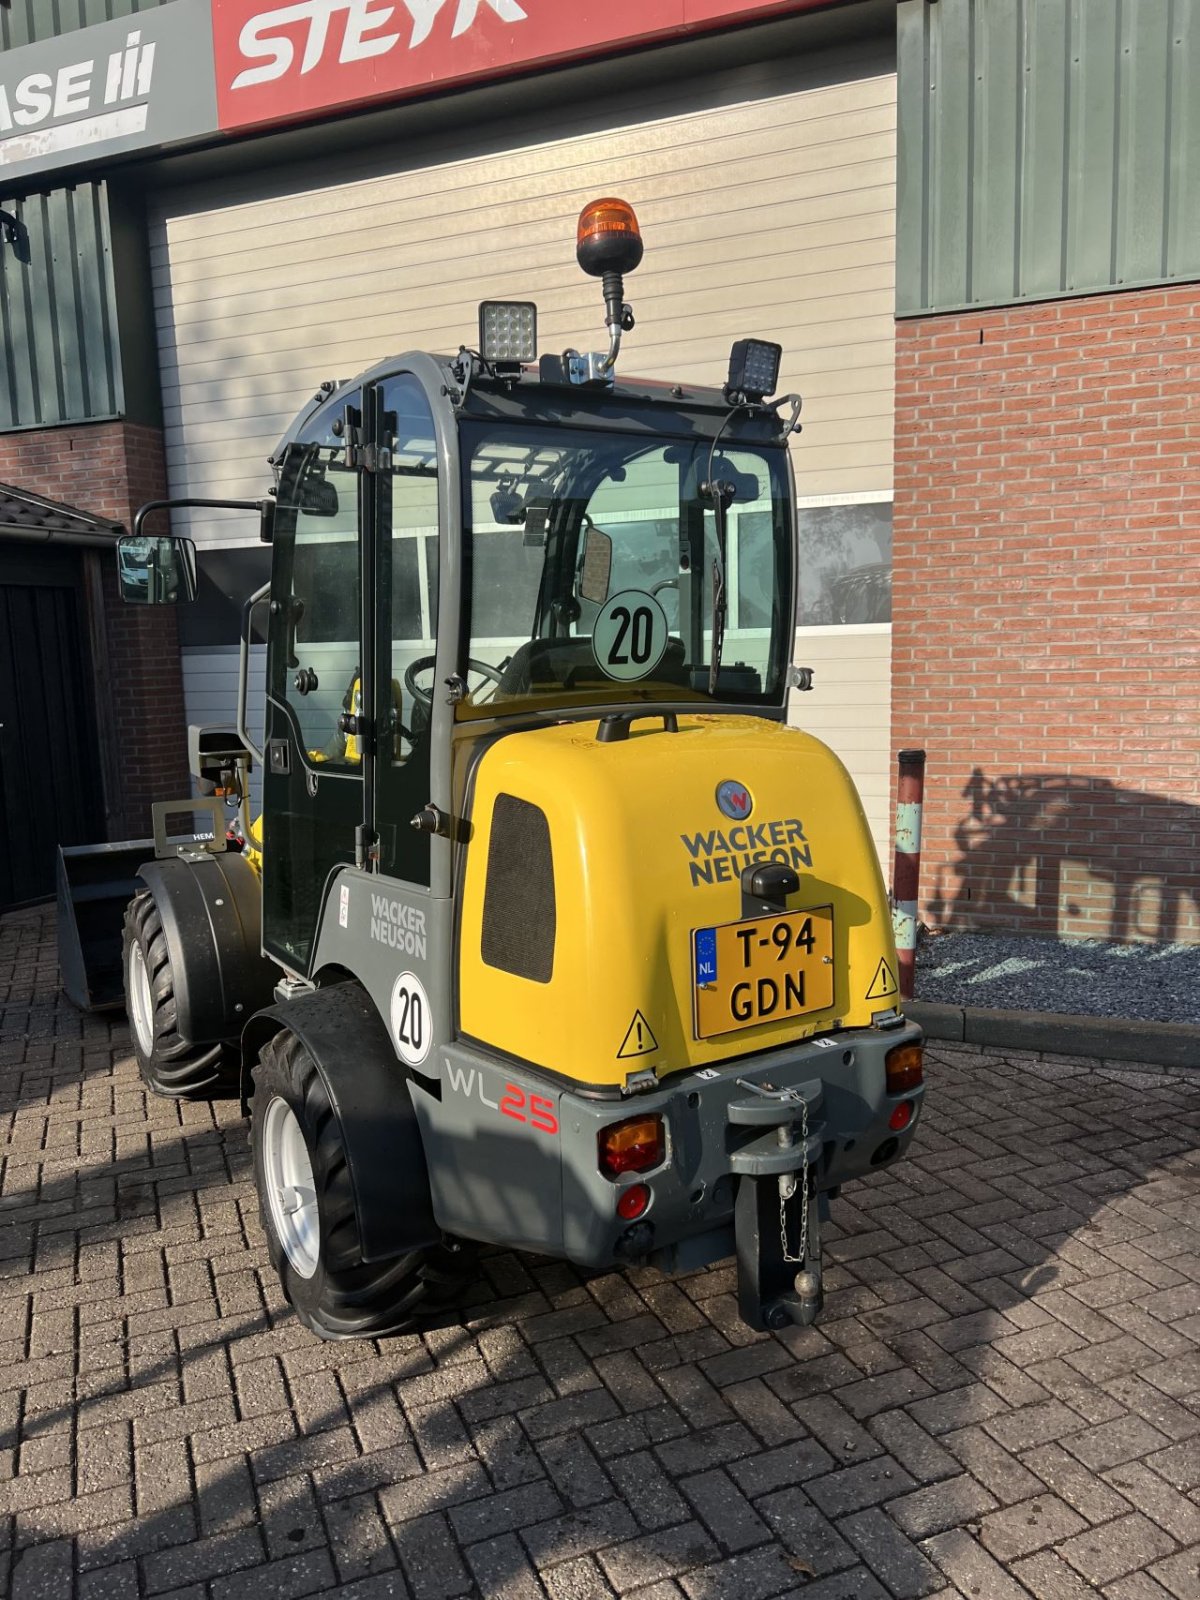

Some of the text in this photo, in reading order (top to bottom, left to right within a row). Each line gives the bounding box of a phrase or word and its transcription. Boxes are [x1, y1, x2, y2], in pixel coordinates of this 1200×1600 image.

[608, 606, 653, 665] 20
[680, 818, 808, 858] WACKER
[371, 893, 426, 936] WACKER
[370, 917, 427, 960] NEUSON
[736, 918, 816, 968] T-94
[699, 962, 714, 975] NL
[399, 987, 422, 1050] 20
[731, 970, 805, 1021] GDN
